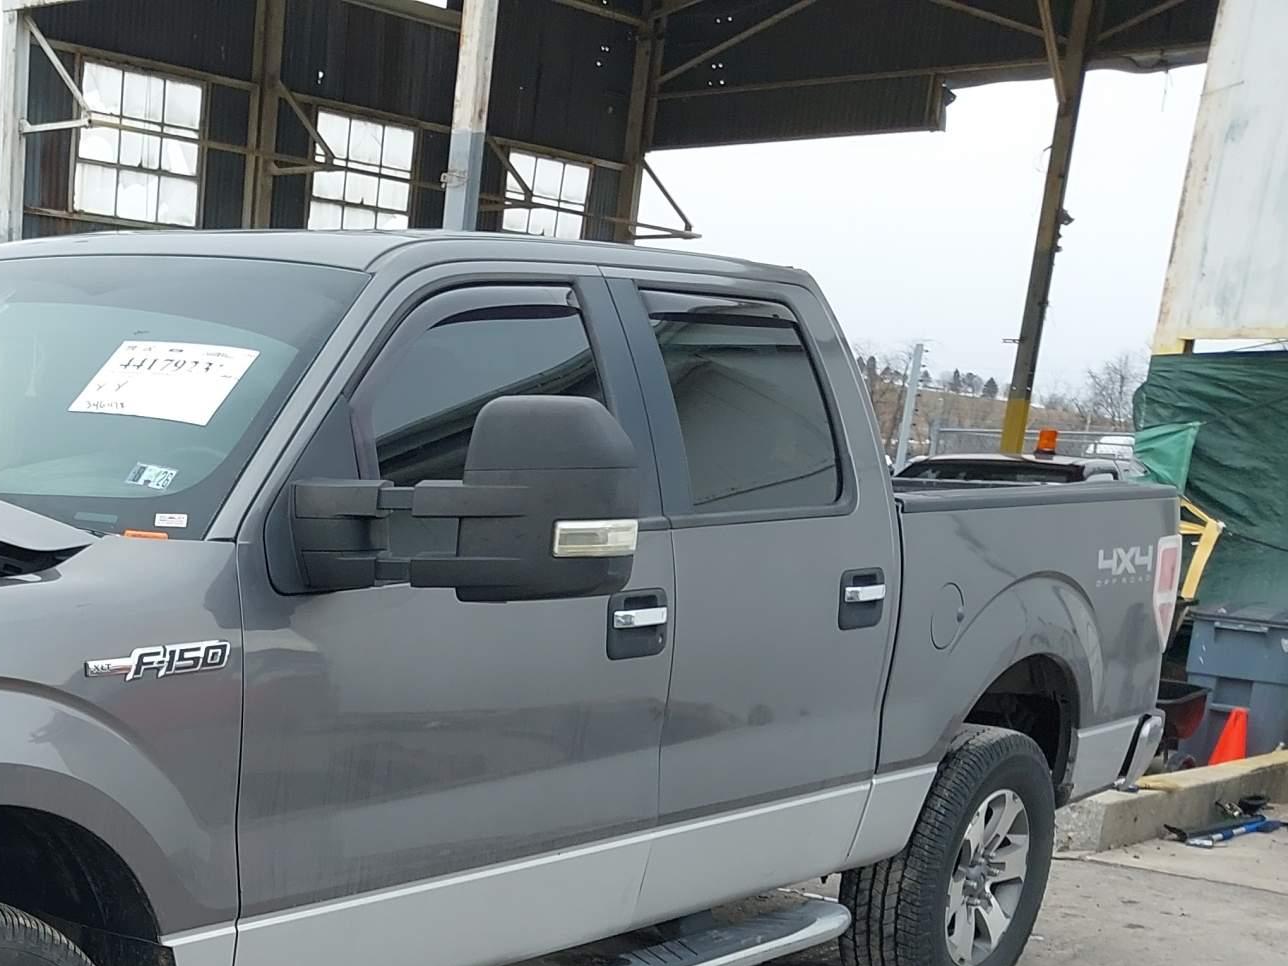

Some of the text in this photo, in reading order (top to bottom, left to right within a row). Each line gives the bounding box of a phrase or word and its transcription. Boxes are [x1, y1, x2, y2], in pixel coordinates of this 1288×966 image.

[119, 357, 225, 374] 4417923
[1097, 544, 1154, 576] 4X4
[128, 642, 231, 680] F-150
